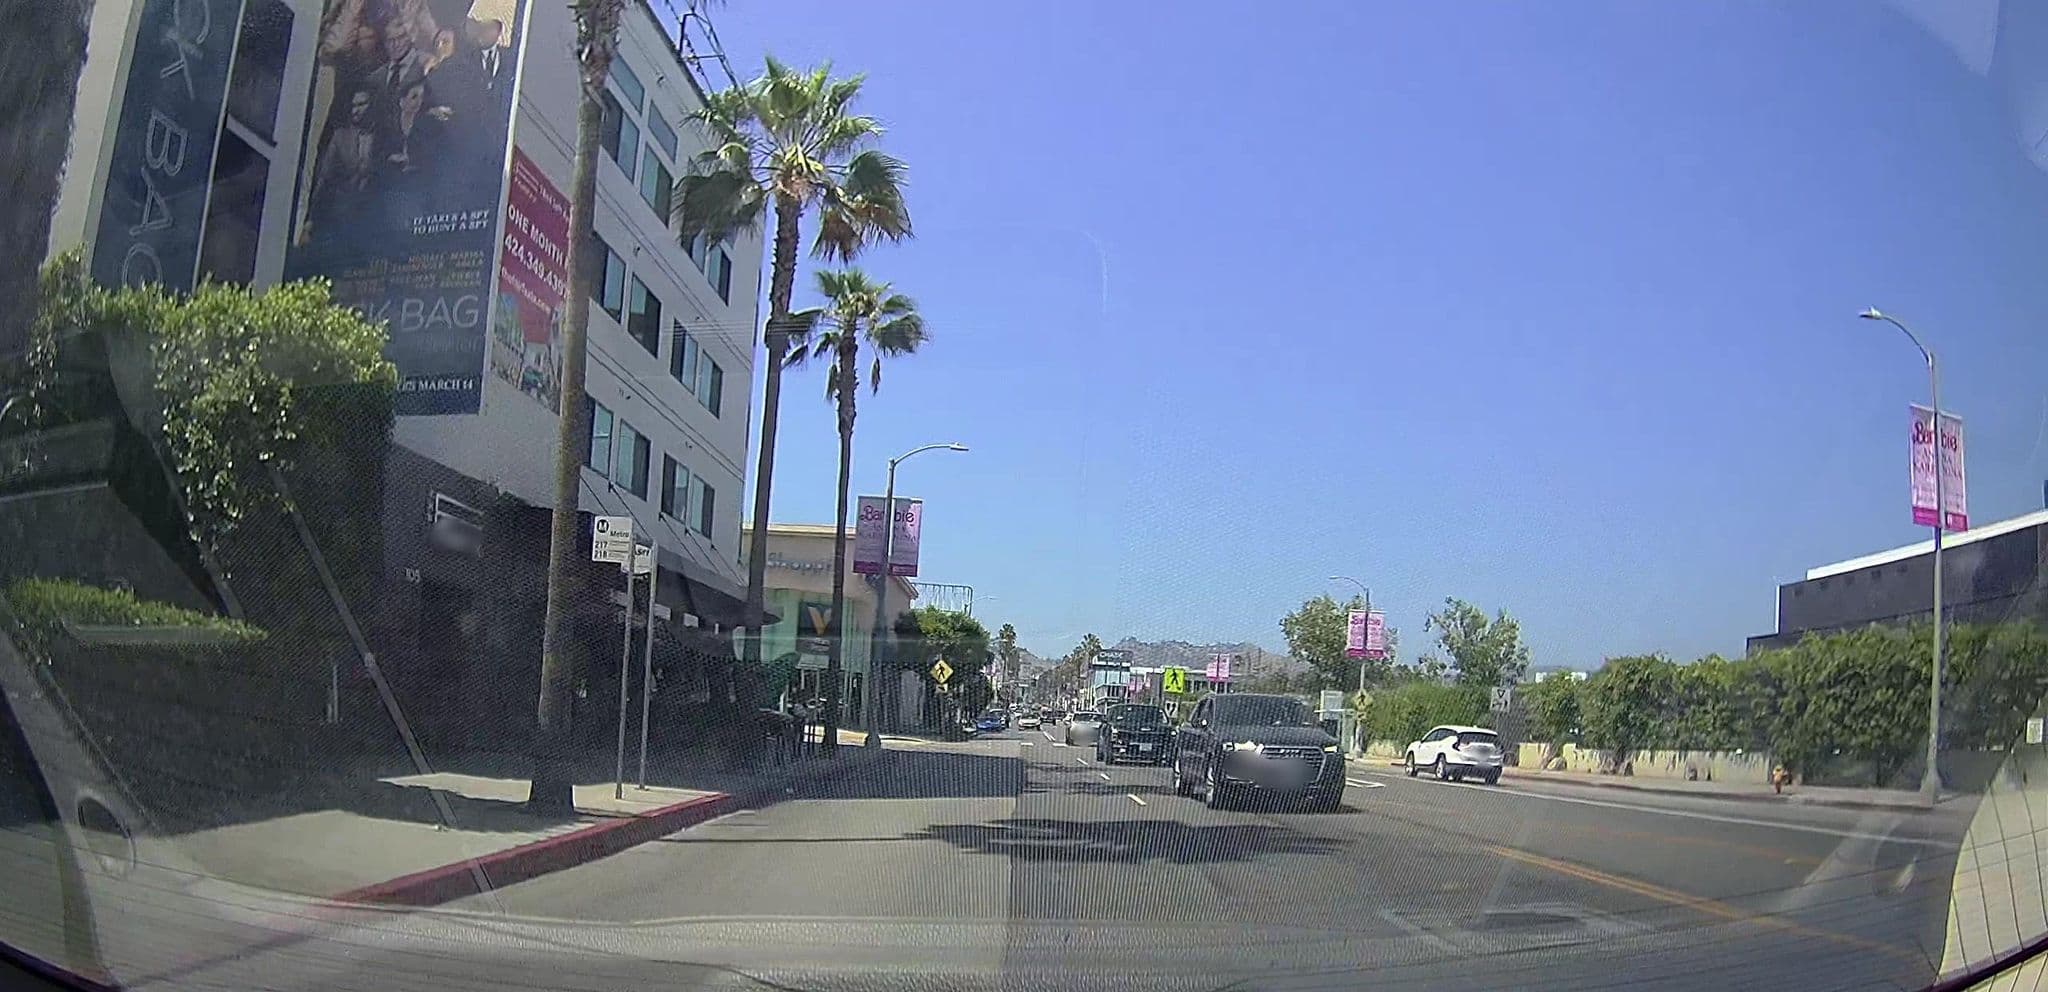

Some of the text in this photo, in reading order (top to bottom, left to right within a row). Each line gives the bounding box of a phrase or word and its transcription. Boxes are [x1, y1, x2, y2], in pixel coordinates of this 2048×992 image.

[508, 203, 530, 235] ONE
[530, 224, 563, 267] MONTH
[400, 294, 480, 332] BAG
[418, 378, 460, 392] MARCH
[610, 530, 630, 538] Metro
[595, 541, 608, 549] 217
